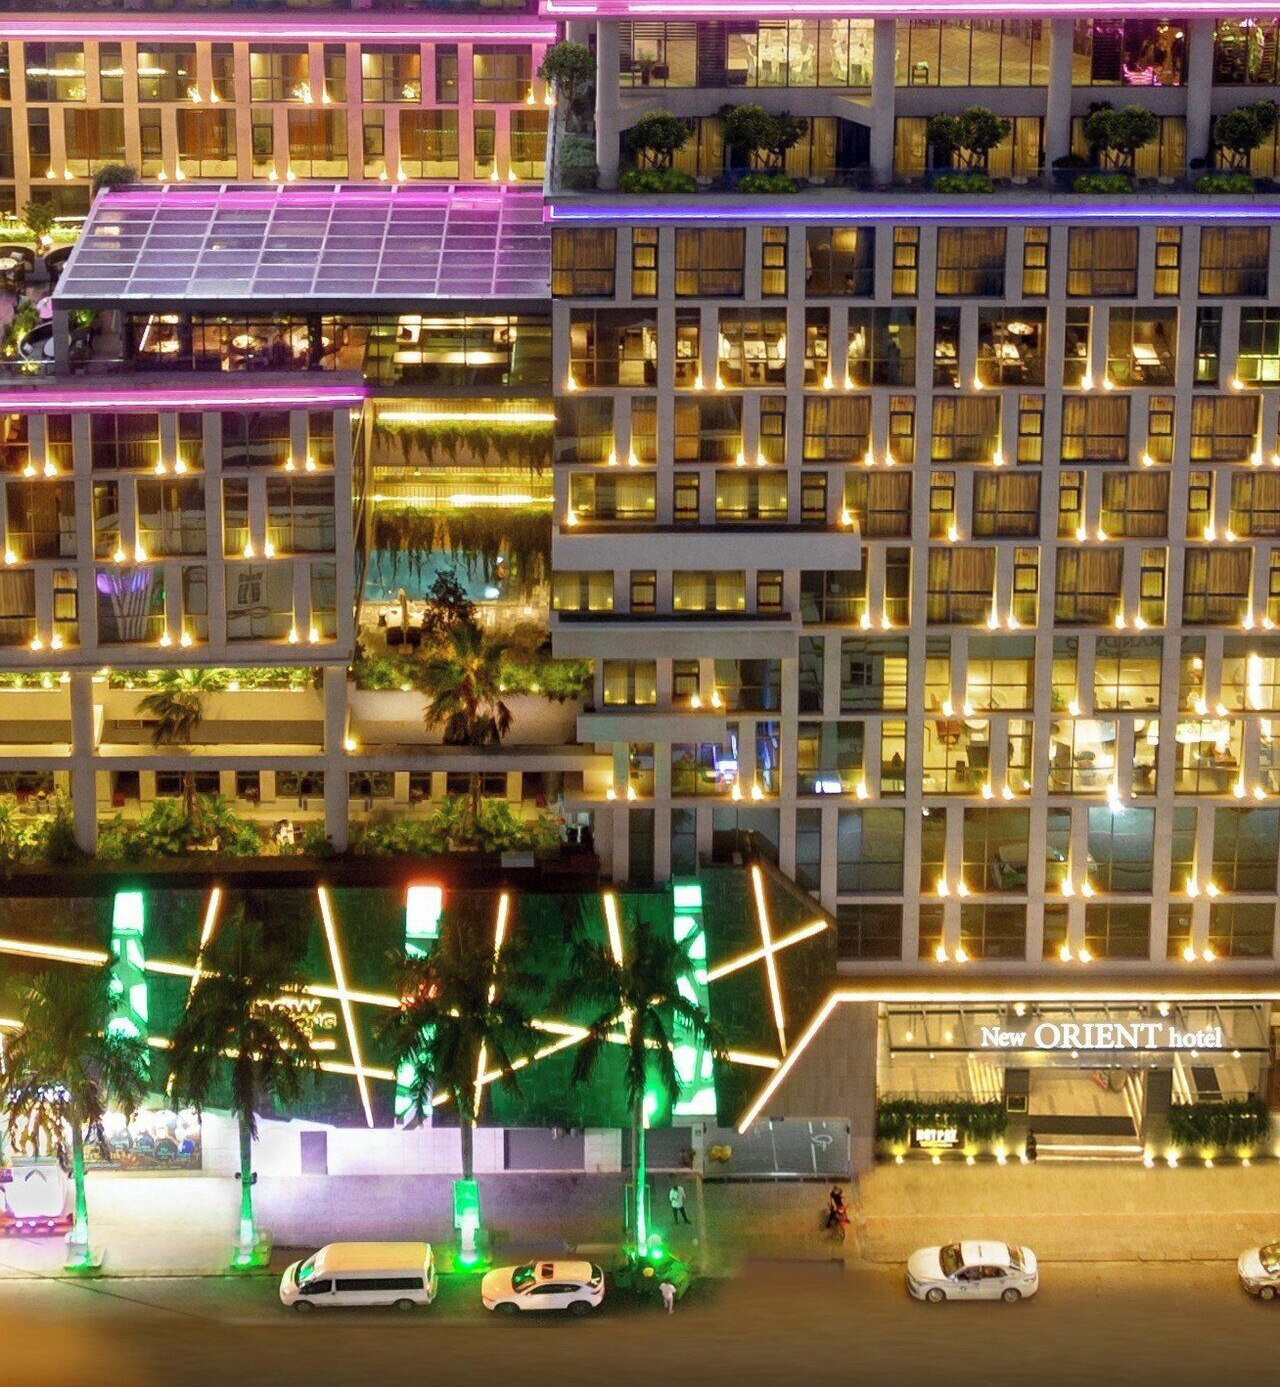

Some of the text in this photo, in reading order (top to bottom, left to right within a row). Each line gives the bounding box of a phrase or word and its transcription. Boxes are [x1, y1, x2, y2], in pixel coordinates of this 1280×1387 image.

[981, 1024, 1223, 1049] New ORIENT hotel
